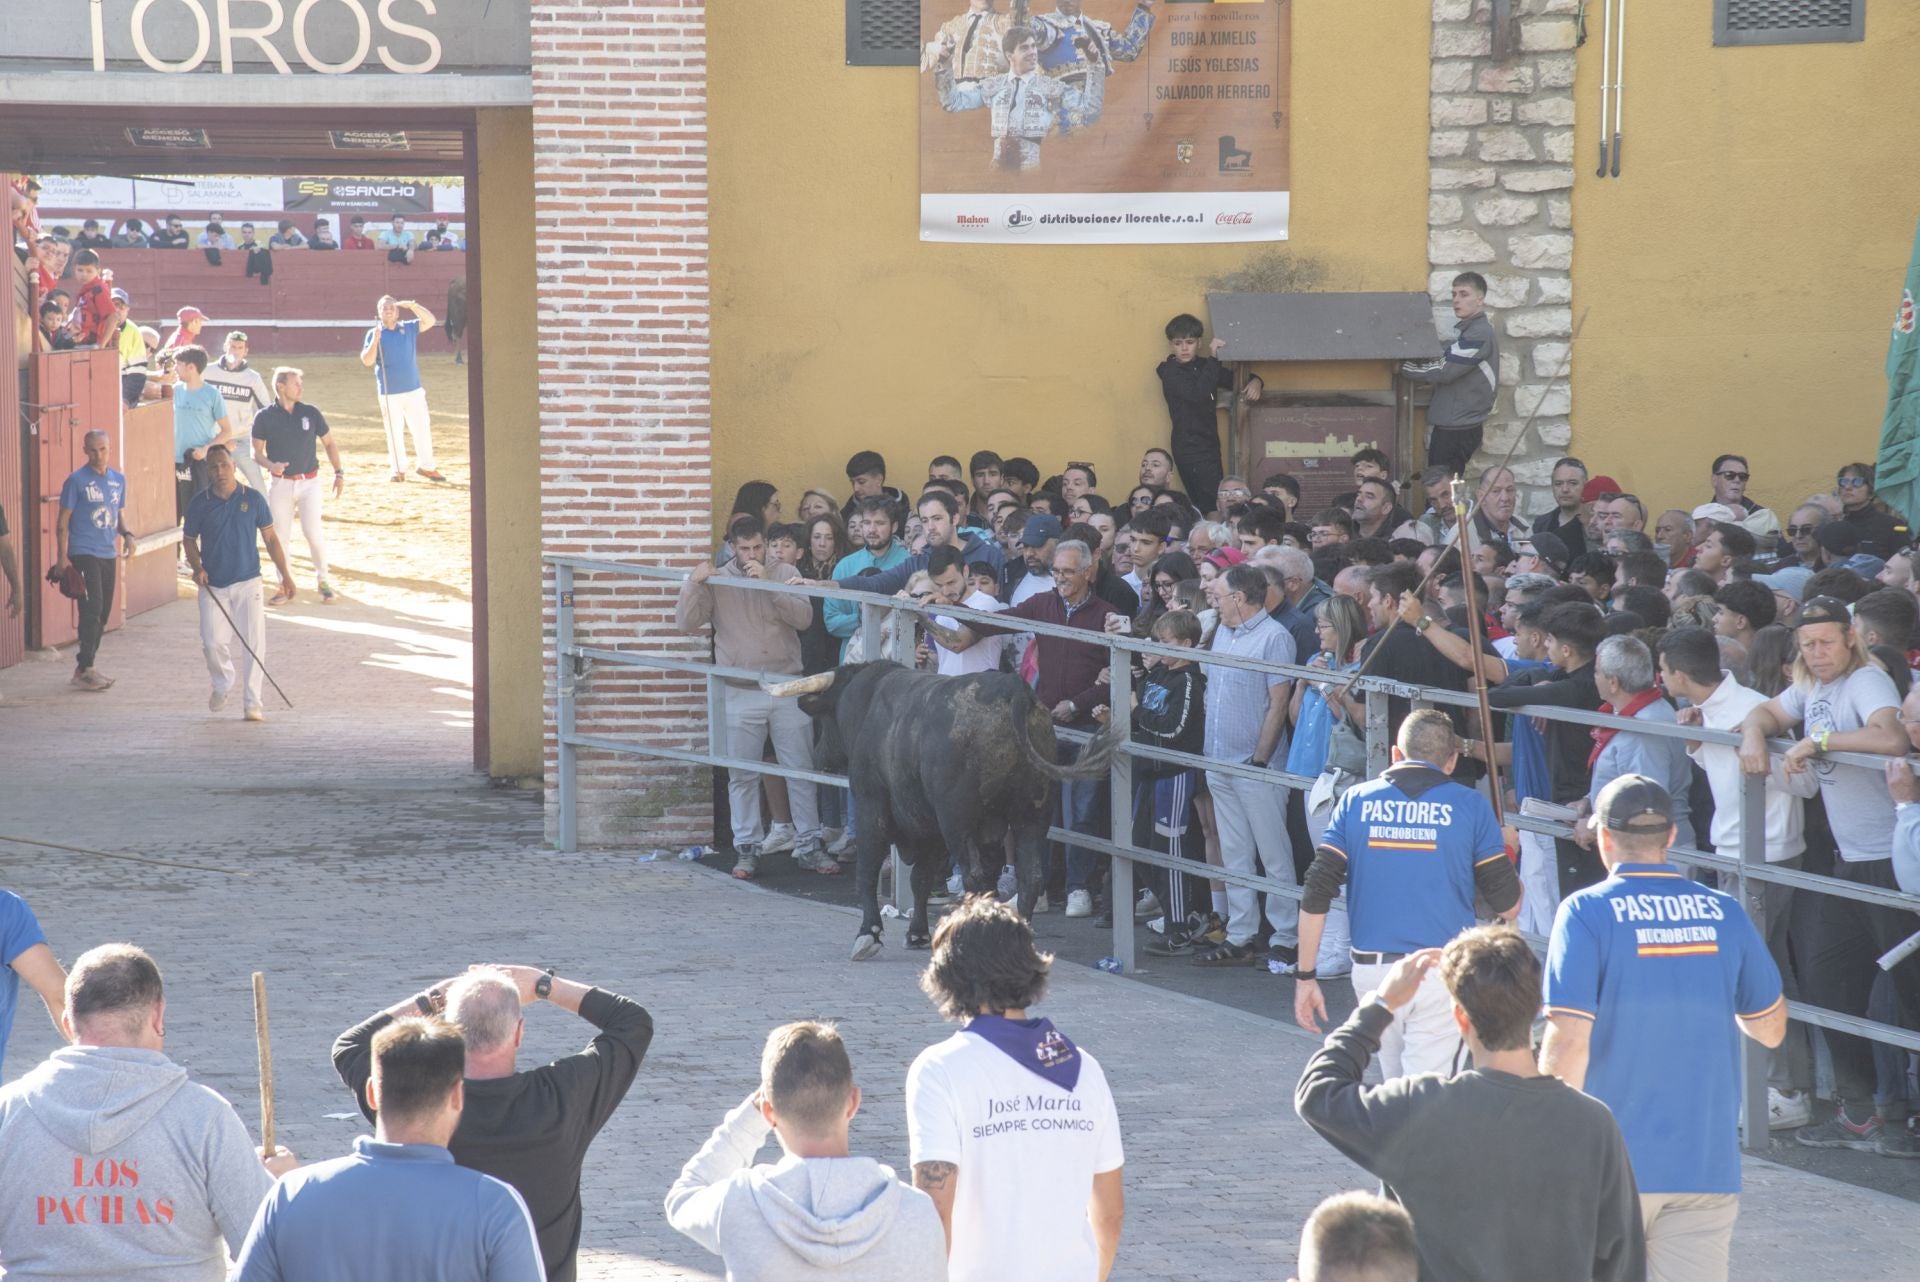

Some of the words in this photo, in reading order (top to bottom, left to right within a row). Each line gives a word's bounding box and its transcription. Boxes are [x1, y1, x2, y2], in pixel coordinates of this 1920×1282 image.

[1168, 13, 1190, 23] para
[1193, 11, 1208, 21] los
[1210, 10, 1260, 21] novilleros
[90, 0, 442, 74] TOROS
[1171, 31, 1207, 47] BORJA
[1209, 31, 1257, 46] XIMELIS
[1168, 56, 1202, 73] JESÚS
[1205, 58, 1260, 73] YGLESIAS
[1156, 85, 1214, 100] SALVADOR
[1217, 84, 1270, 99] HERRERO
[957, 215, 989, 224] Mahou
[1040, 213, 1122, 224] distribuciones
[1361, 799, 1453, 826] PASTORES
[1368, 825, 1438, 841] MUCHOBUENO
[1609, 893, 1725, 923] PASTORES
[1635, 926, 1718, 944] MUCHOBUENO
[988, 1095, 1021, 1119] José
[1026, 1094, 1082, 1112] María
[972, 1119, 1028, 1138] SIEMPRE
[1031, 1118, 1095, 1132] CONMIGO
[73, 1156, 139, 1188] LOS
[37, 1194, 175, 1226] PACHAS
